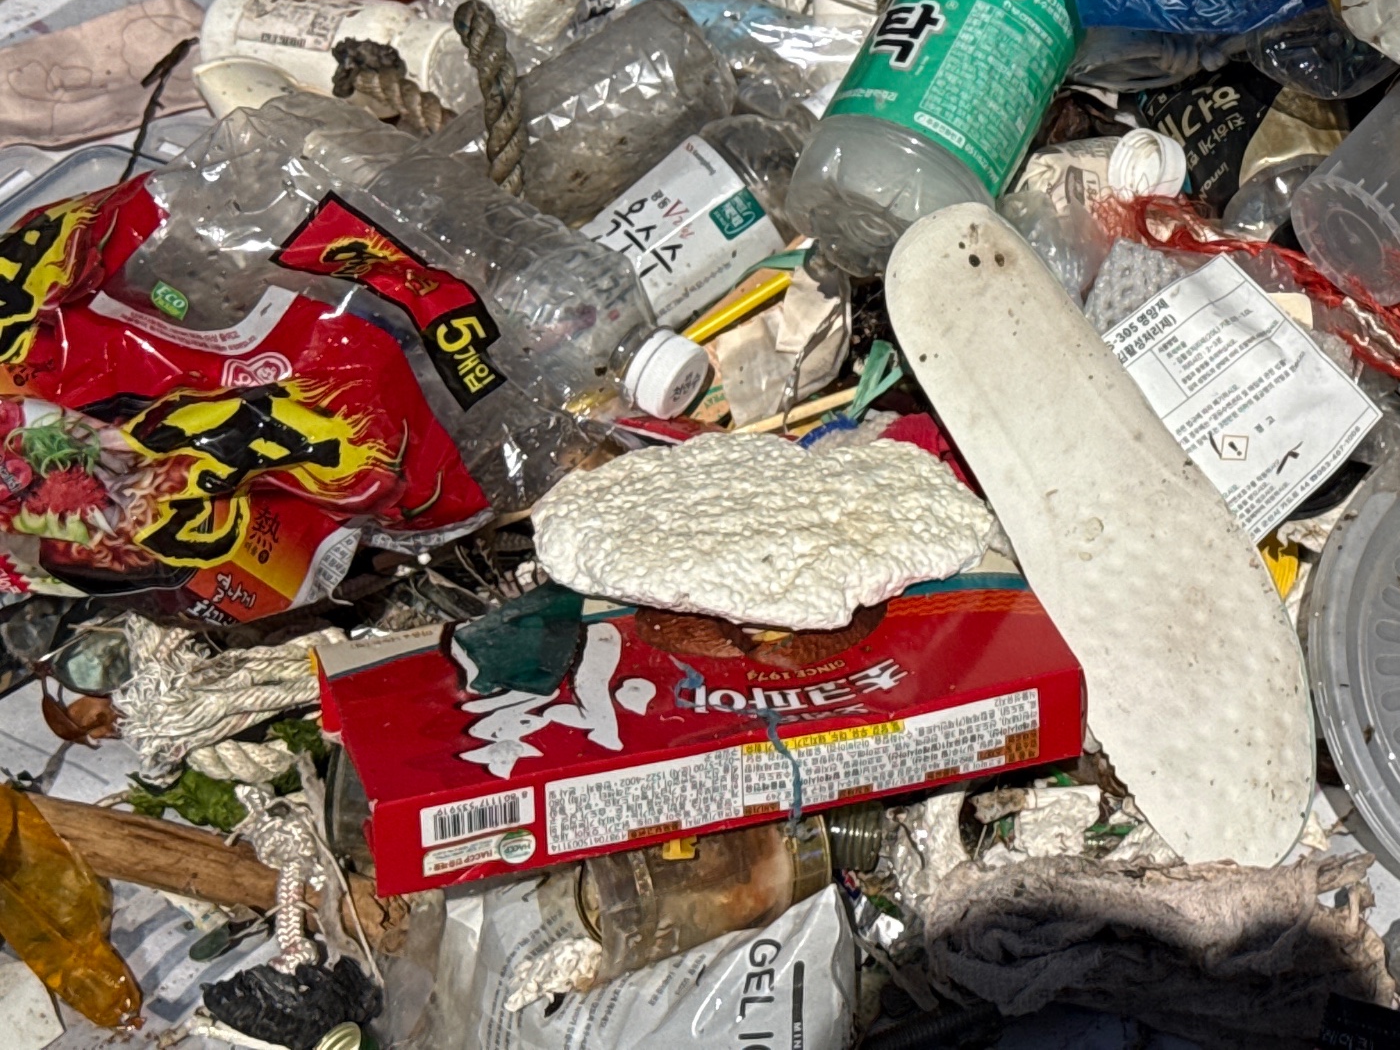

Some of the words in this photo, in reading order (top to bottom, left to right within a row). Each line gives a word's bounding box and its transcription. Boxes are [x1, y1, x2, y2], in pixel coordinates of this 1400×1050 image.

[872, 2, 944, 68] 탁
[1197, 112, 1247, 156] 진하게
[156, 286, 186, 309] ECO
[1136, 296, 1169, 326] 영양제
[429, 305, 496, 394] 5개입
[1298, 479, 1310, 492] 44
[249, 506, 281, 545] 熱
[746, 669, 790, 682] 1974
[794, 659, 845, 678] SINCE
[690, 657, 907, 715] 초코파이
[479, 793, 516, 806] 801117
[765, 791, 782, 800] 249
[463, 850, 492, 863] HACCP
[502, 842, 530, 854] HACCP
[736, 939, 781, 1020] GEL
